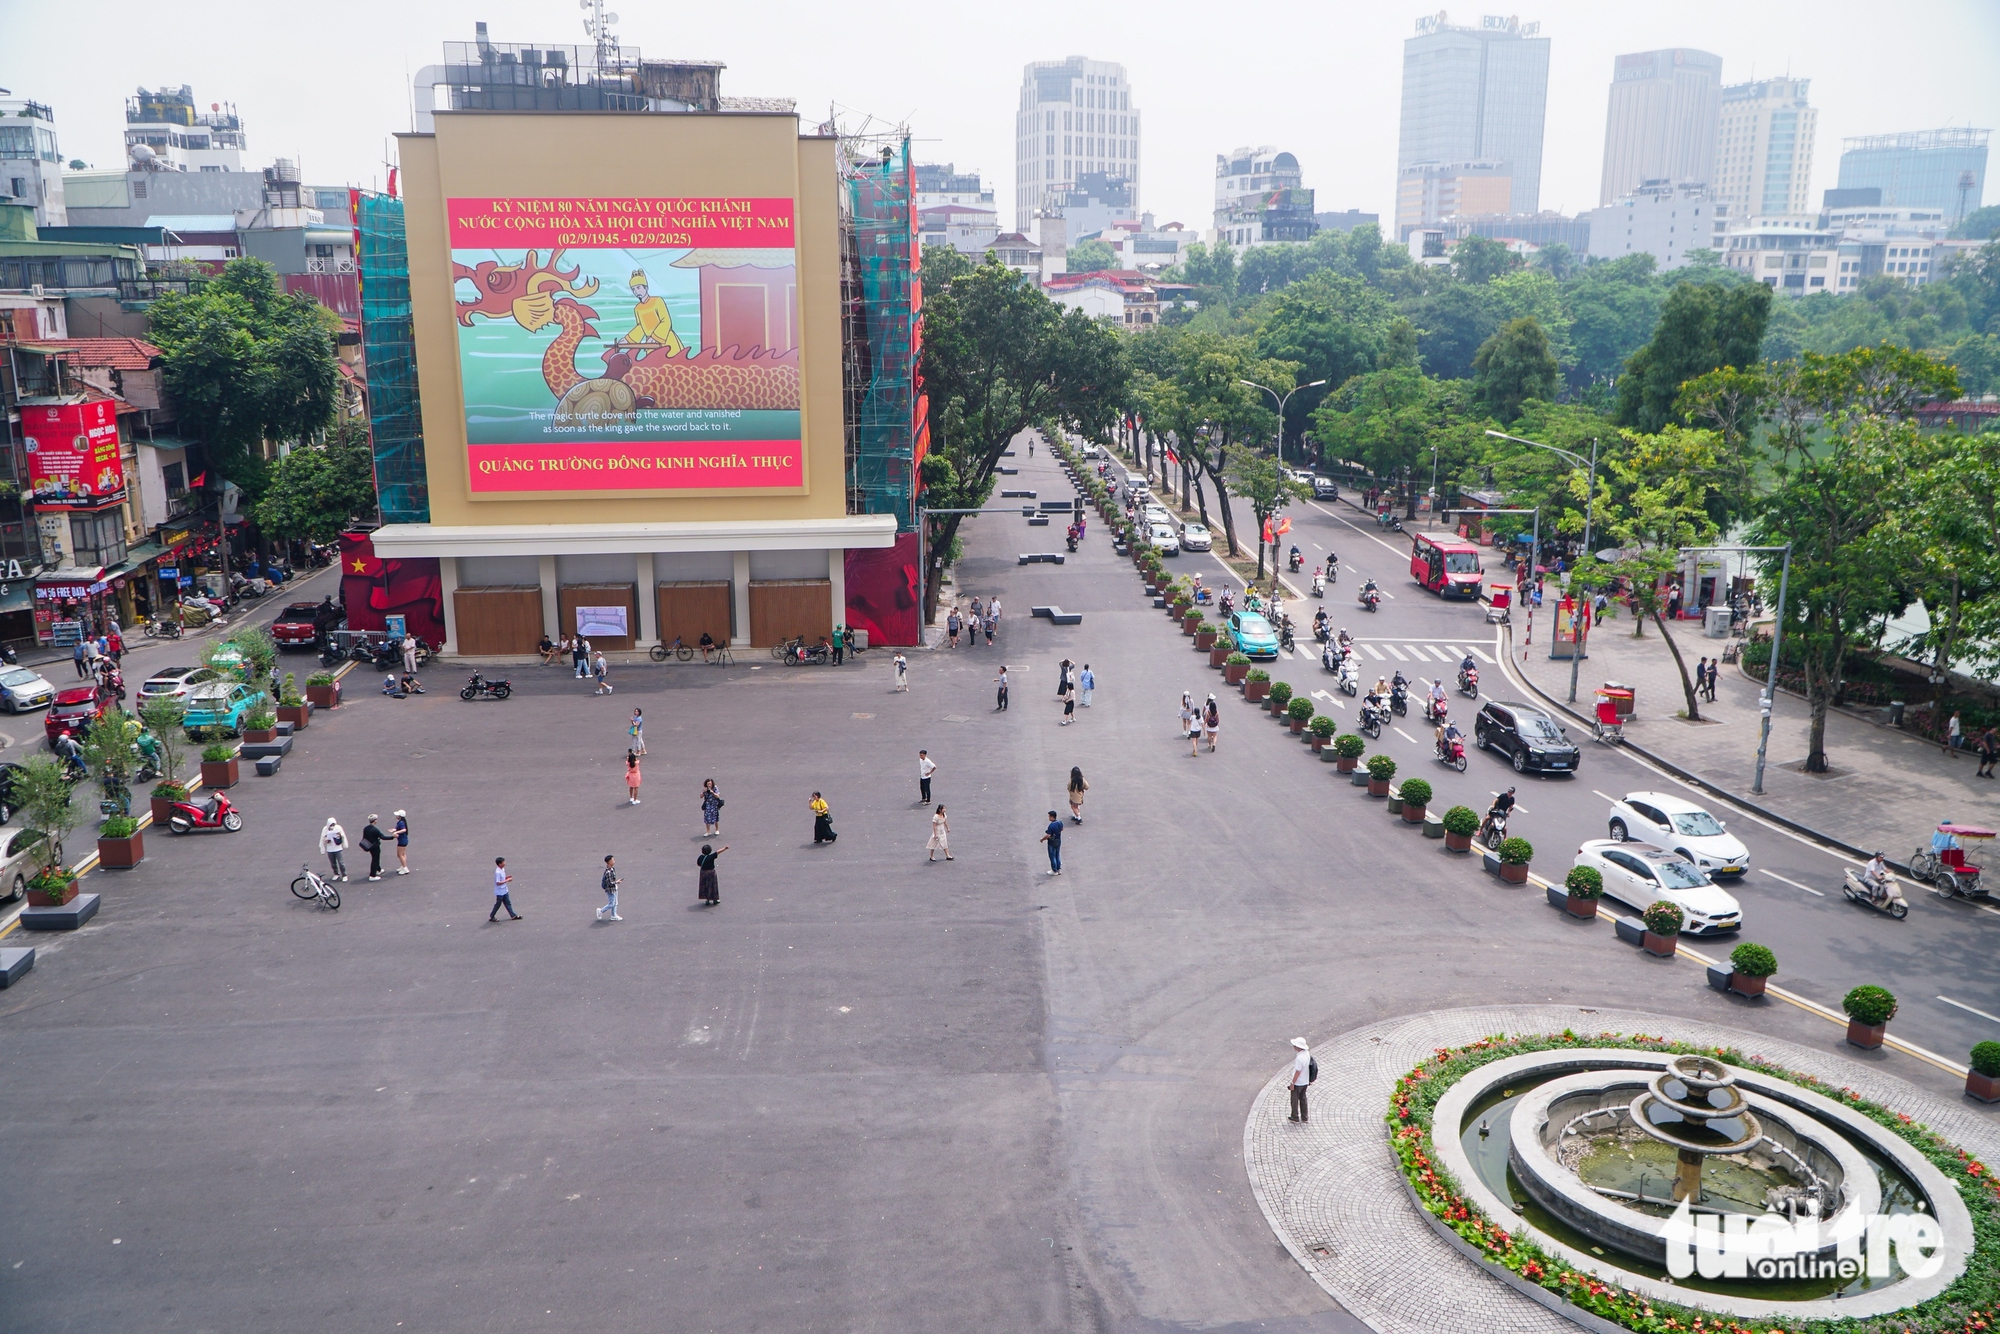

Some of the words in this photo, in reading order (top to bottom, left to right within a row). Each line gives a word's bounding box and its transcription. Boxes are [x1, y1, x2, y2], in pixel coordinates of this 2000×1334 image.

[1415, 13, 1437, 31] BIDV
[1483, 15, 1509, 29] BIDV
[1616, 68, 1653, 81] GROUP
[493, 198, 513, 213] KỶ
[517, 201, 554, 215] NIỆM
[558, 202, 572, 213] 80
[576, 199, 608, 212] NĂM
[612, 199, 651, 212] NGÀY
[656, 199, 697, 214] QUỐC
[701, 199, 751, 213] KHÁNH
[458, 215, 500, 229] NƯỚC
[504, 216, 546, 231] CỘNG
[550, 215, 581, 229] HÒA
[585, 215, 604, 229] XÃ
[608, 216, 634, 231] HỘI
[637, 215, 667, 229] CHỦ
[671, 215, 717, 229] NGHĨA
[721, 216, 753, 231] VIỆT
[757, 217, 789, 228] NAM
[557, 233, 620, 247] (02/9/1945
[630, 232, 692, 246] 02/9/2025)
[529, 411, 546, 420] The
[548, 412, 572, 422] magic
[575, 411, 599, 420] turtle
[601, 410, 622, 420] dove
[625, 411, 642, 419] into
[644, 410, 659, 419] the
[660, 411, 684, 419] water
[686, 410, 702, 418] and
[704, 409, 741, 418] vanished
[89, 427, 104, 438] NGỌC
[105, 424, 116, 435] HOA
[577, 425, 586, 433] as
[588, 424, 603, 432] the
[605, 423, 622, 434] king
[624, 425, 643, 434] gave
[645, 423, 660, 431] the
[662, 422, 687, 431] sword
[689, 422, 709, 431] back
[723, 422, 732, 430] it.
[478, 457, 534, 474] QUẢNG
[538, 455, 604, 471] TRƯỜNG
[607, 454, 651, 470] ĐÔNG
[656, 457, 694, 469] KINH
[698, 453, 748, 468] NGHĨA
[752, 456, 792, 470] THỤC
[36, 588, 47, 598] SIM
[48, 587, 56, 597] 5G
[57, 587, 71, 597] FREE
[71, 586, 86, 597] DATA
